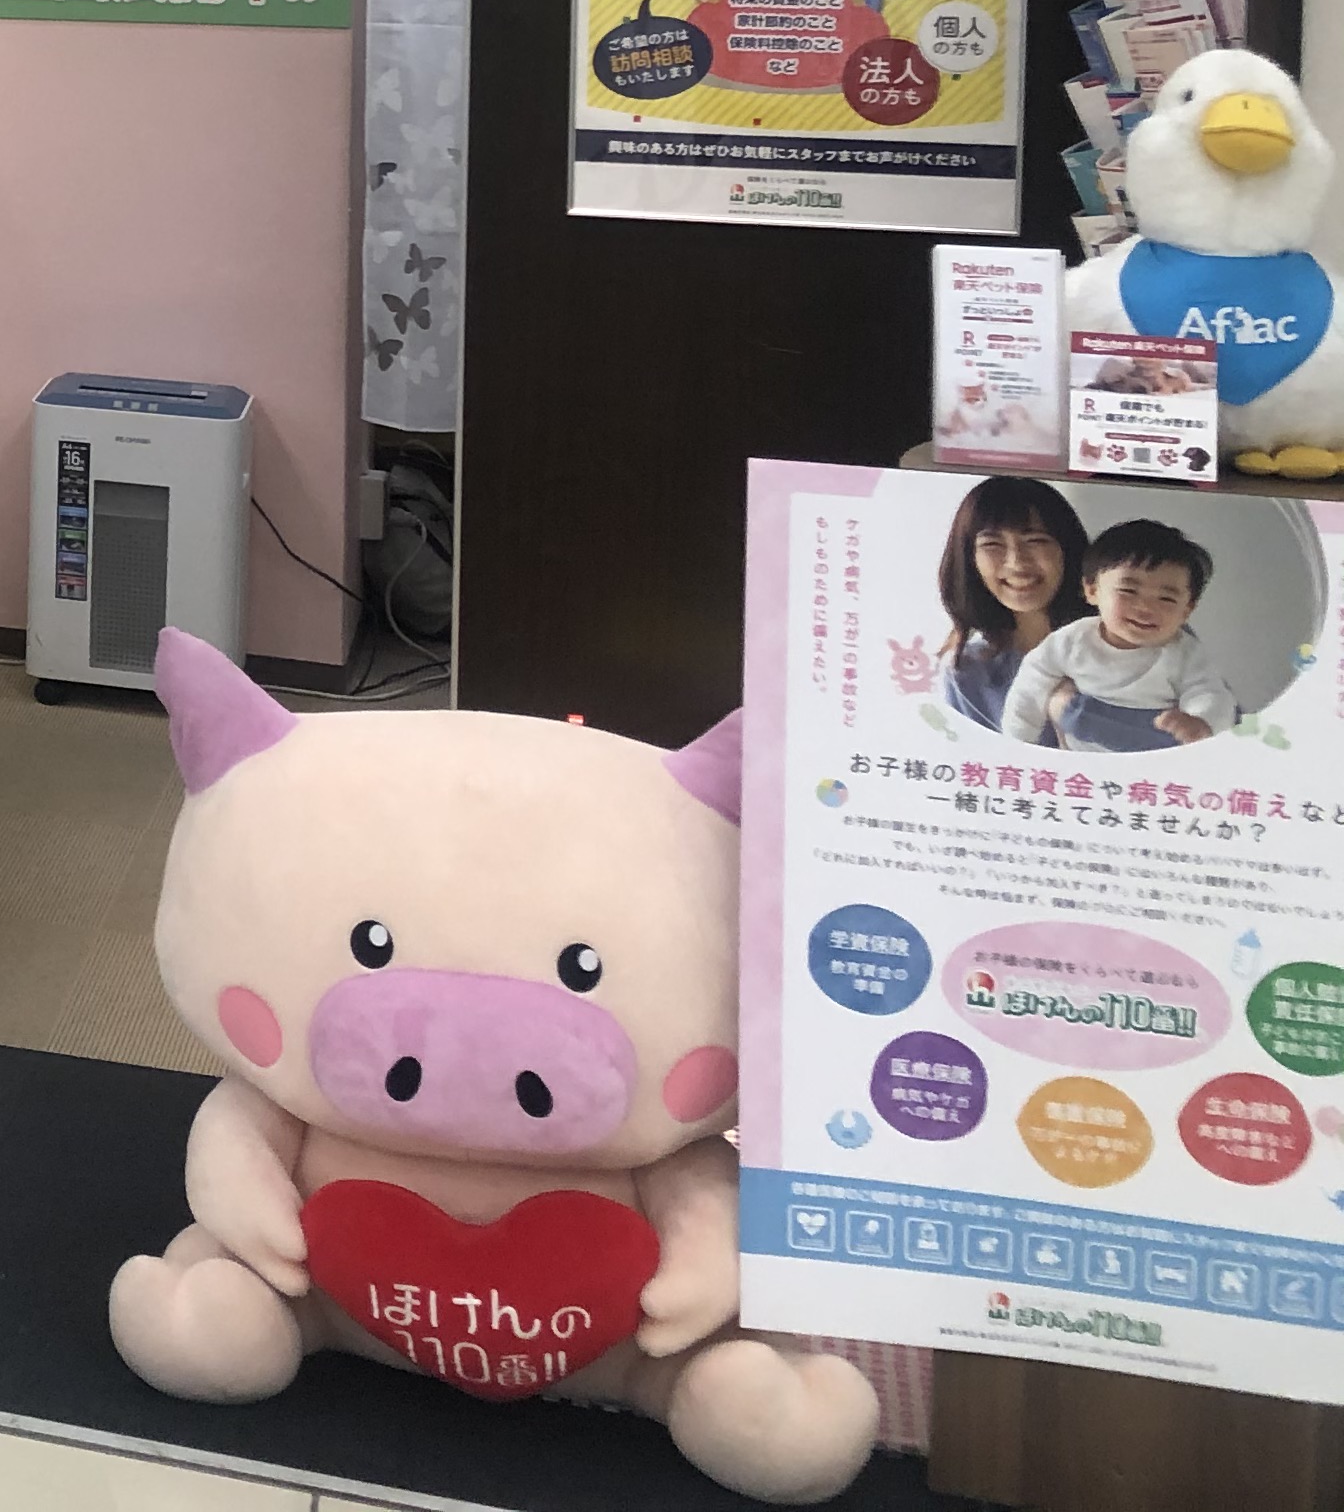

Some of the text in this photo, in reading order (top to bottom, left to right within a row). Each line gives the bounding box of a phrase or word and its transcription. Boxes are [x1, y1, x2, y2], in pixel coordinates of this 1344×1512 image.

[737, 13, 836, 31] 家計節約のこと
[933, 15, 986, 40] 個人
[608, 27, 689, 52] ご希望の方は
[728, 35, 843, 53] 保険料控除のこと
[933, 40, 985, 57] の方も
[609, 43, 694, 73] 訪問相談
[767, 59, 798, 75] など
[614, 65, 695, 87] もいたします
[860, 56, 925, 87] 法人
[861, 88, 921, 106] の方も
[951, 262, 1014, 278] Rakuten
[1082, 337, 1132, 351] Rakuten
[65, 450, 81, 466] 16
[926, 790, 1268, 843] 一緒に考えてみませんか？
[368, 1282, 592, 1340] ほけんの
